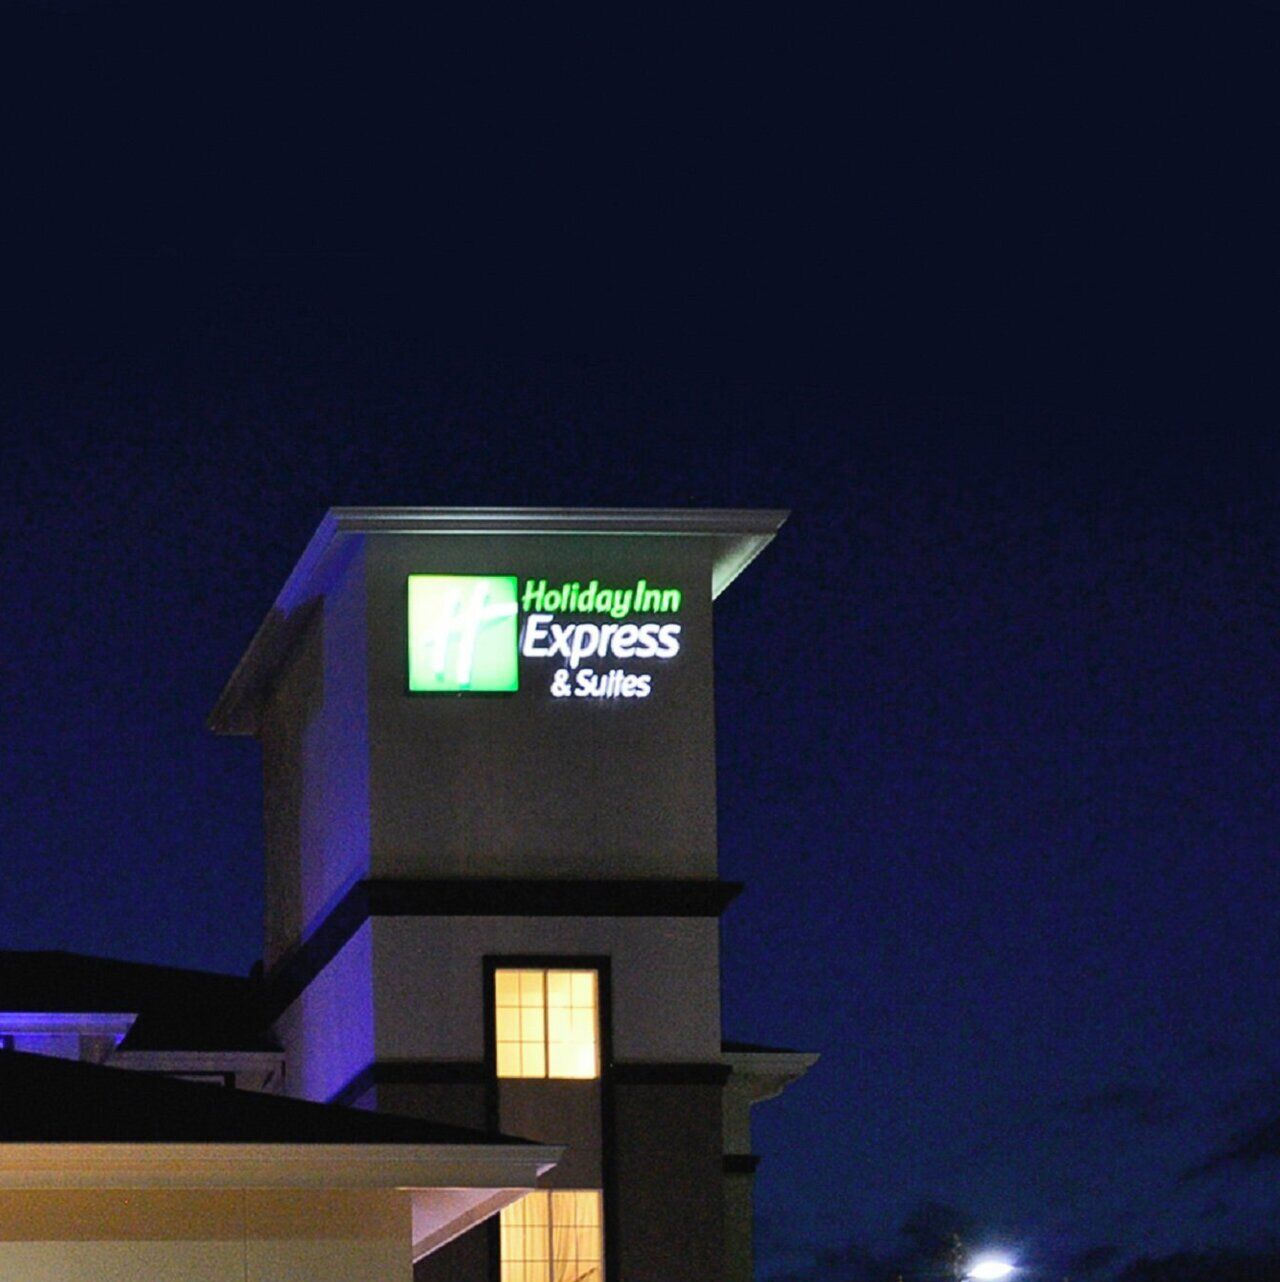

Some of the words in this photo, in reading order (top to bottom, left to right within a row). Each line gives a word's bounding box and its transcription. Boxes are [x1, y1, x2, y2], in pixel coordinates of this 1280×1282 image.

[522, 580, 632, 618] Holiday
[633, 580, 681, 612] Inn
[520, 614, 681, 669] Express
[550, 669, 571, 697] &
[574, 669, 651, 698] Suites
